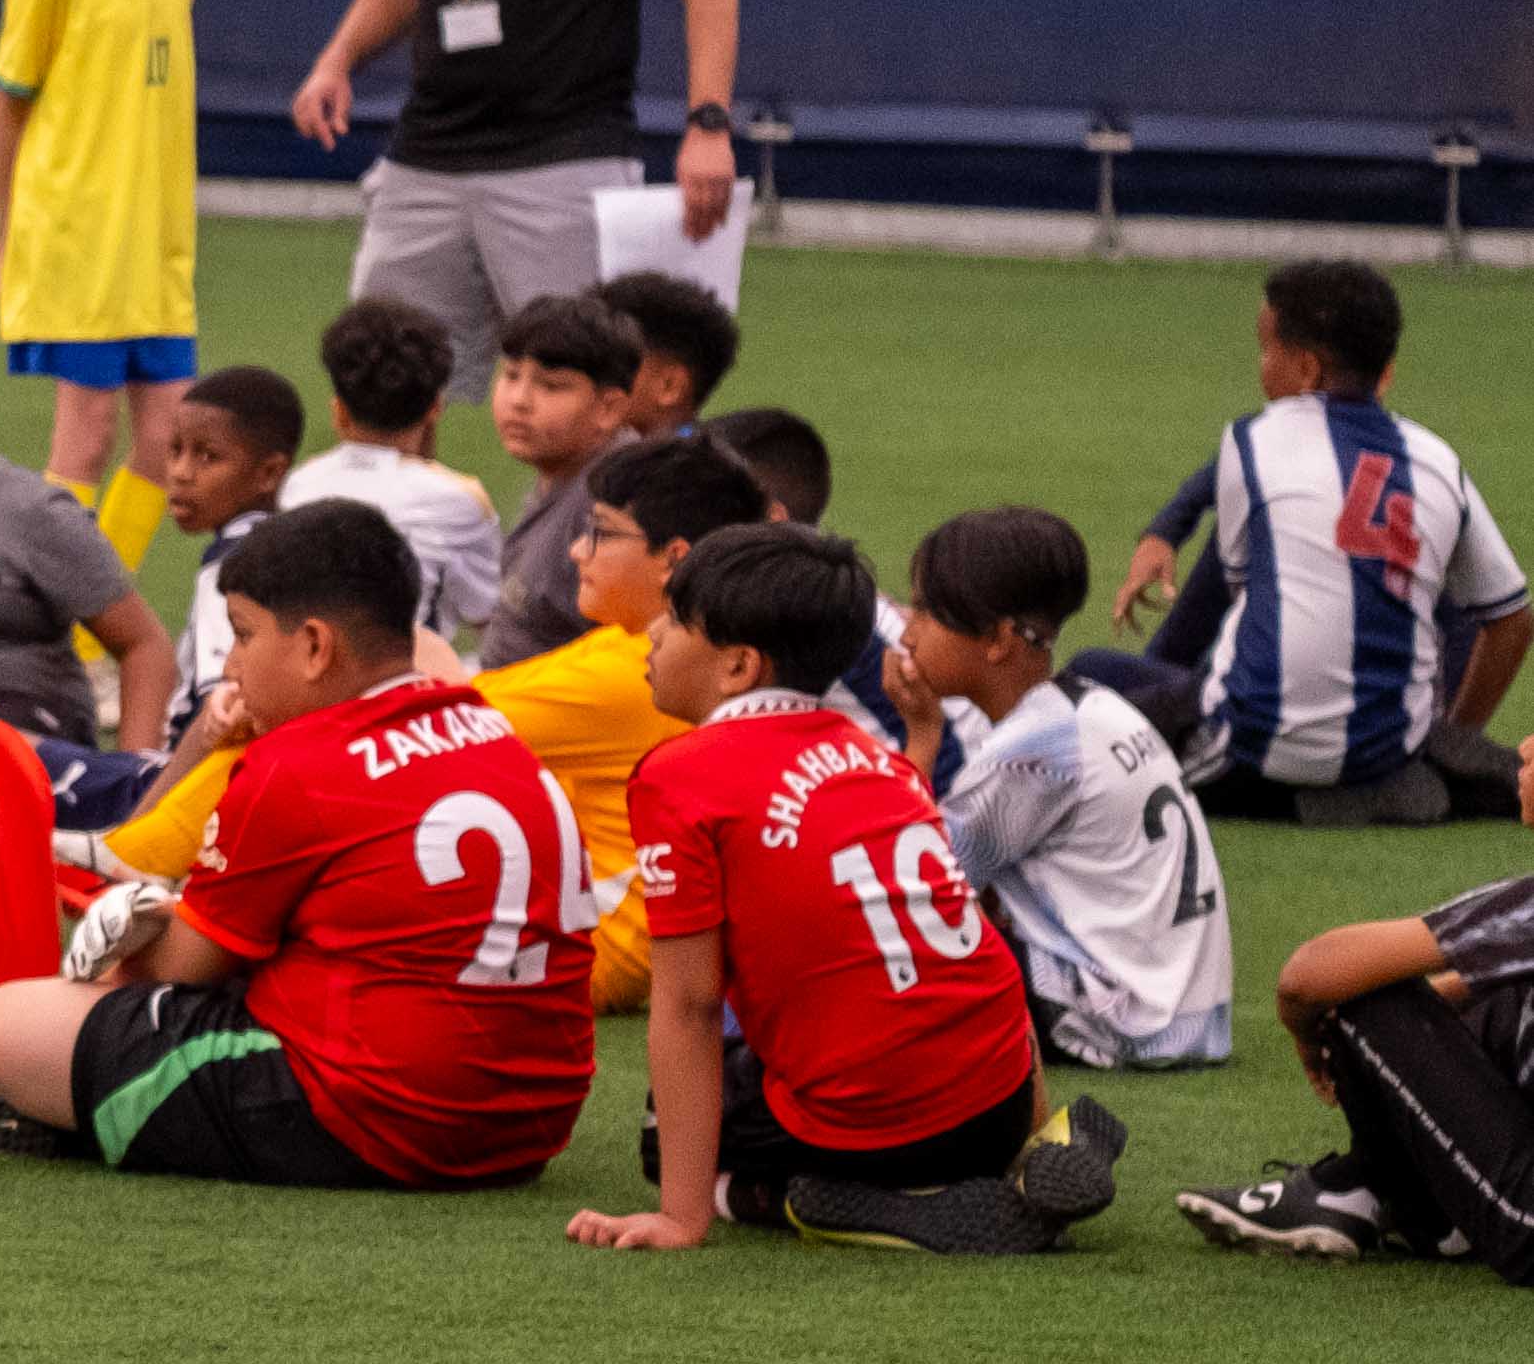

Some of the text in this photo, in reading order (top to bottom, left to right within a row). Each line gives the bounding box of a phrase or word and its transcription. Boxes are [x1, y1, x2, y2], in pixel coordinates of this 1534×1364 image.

[1333, 449, 1421, 601] 4
[414, 767, 599, 985] 24
[830, 822, 983, 995] 10
[1142, 783, 1217, 927] 2
